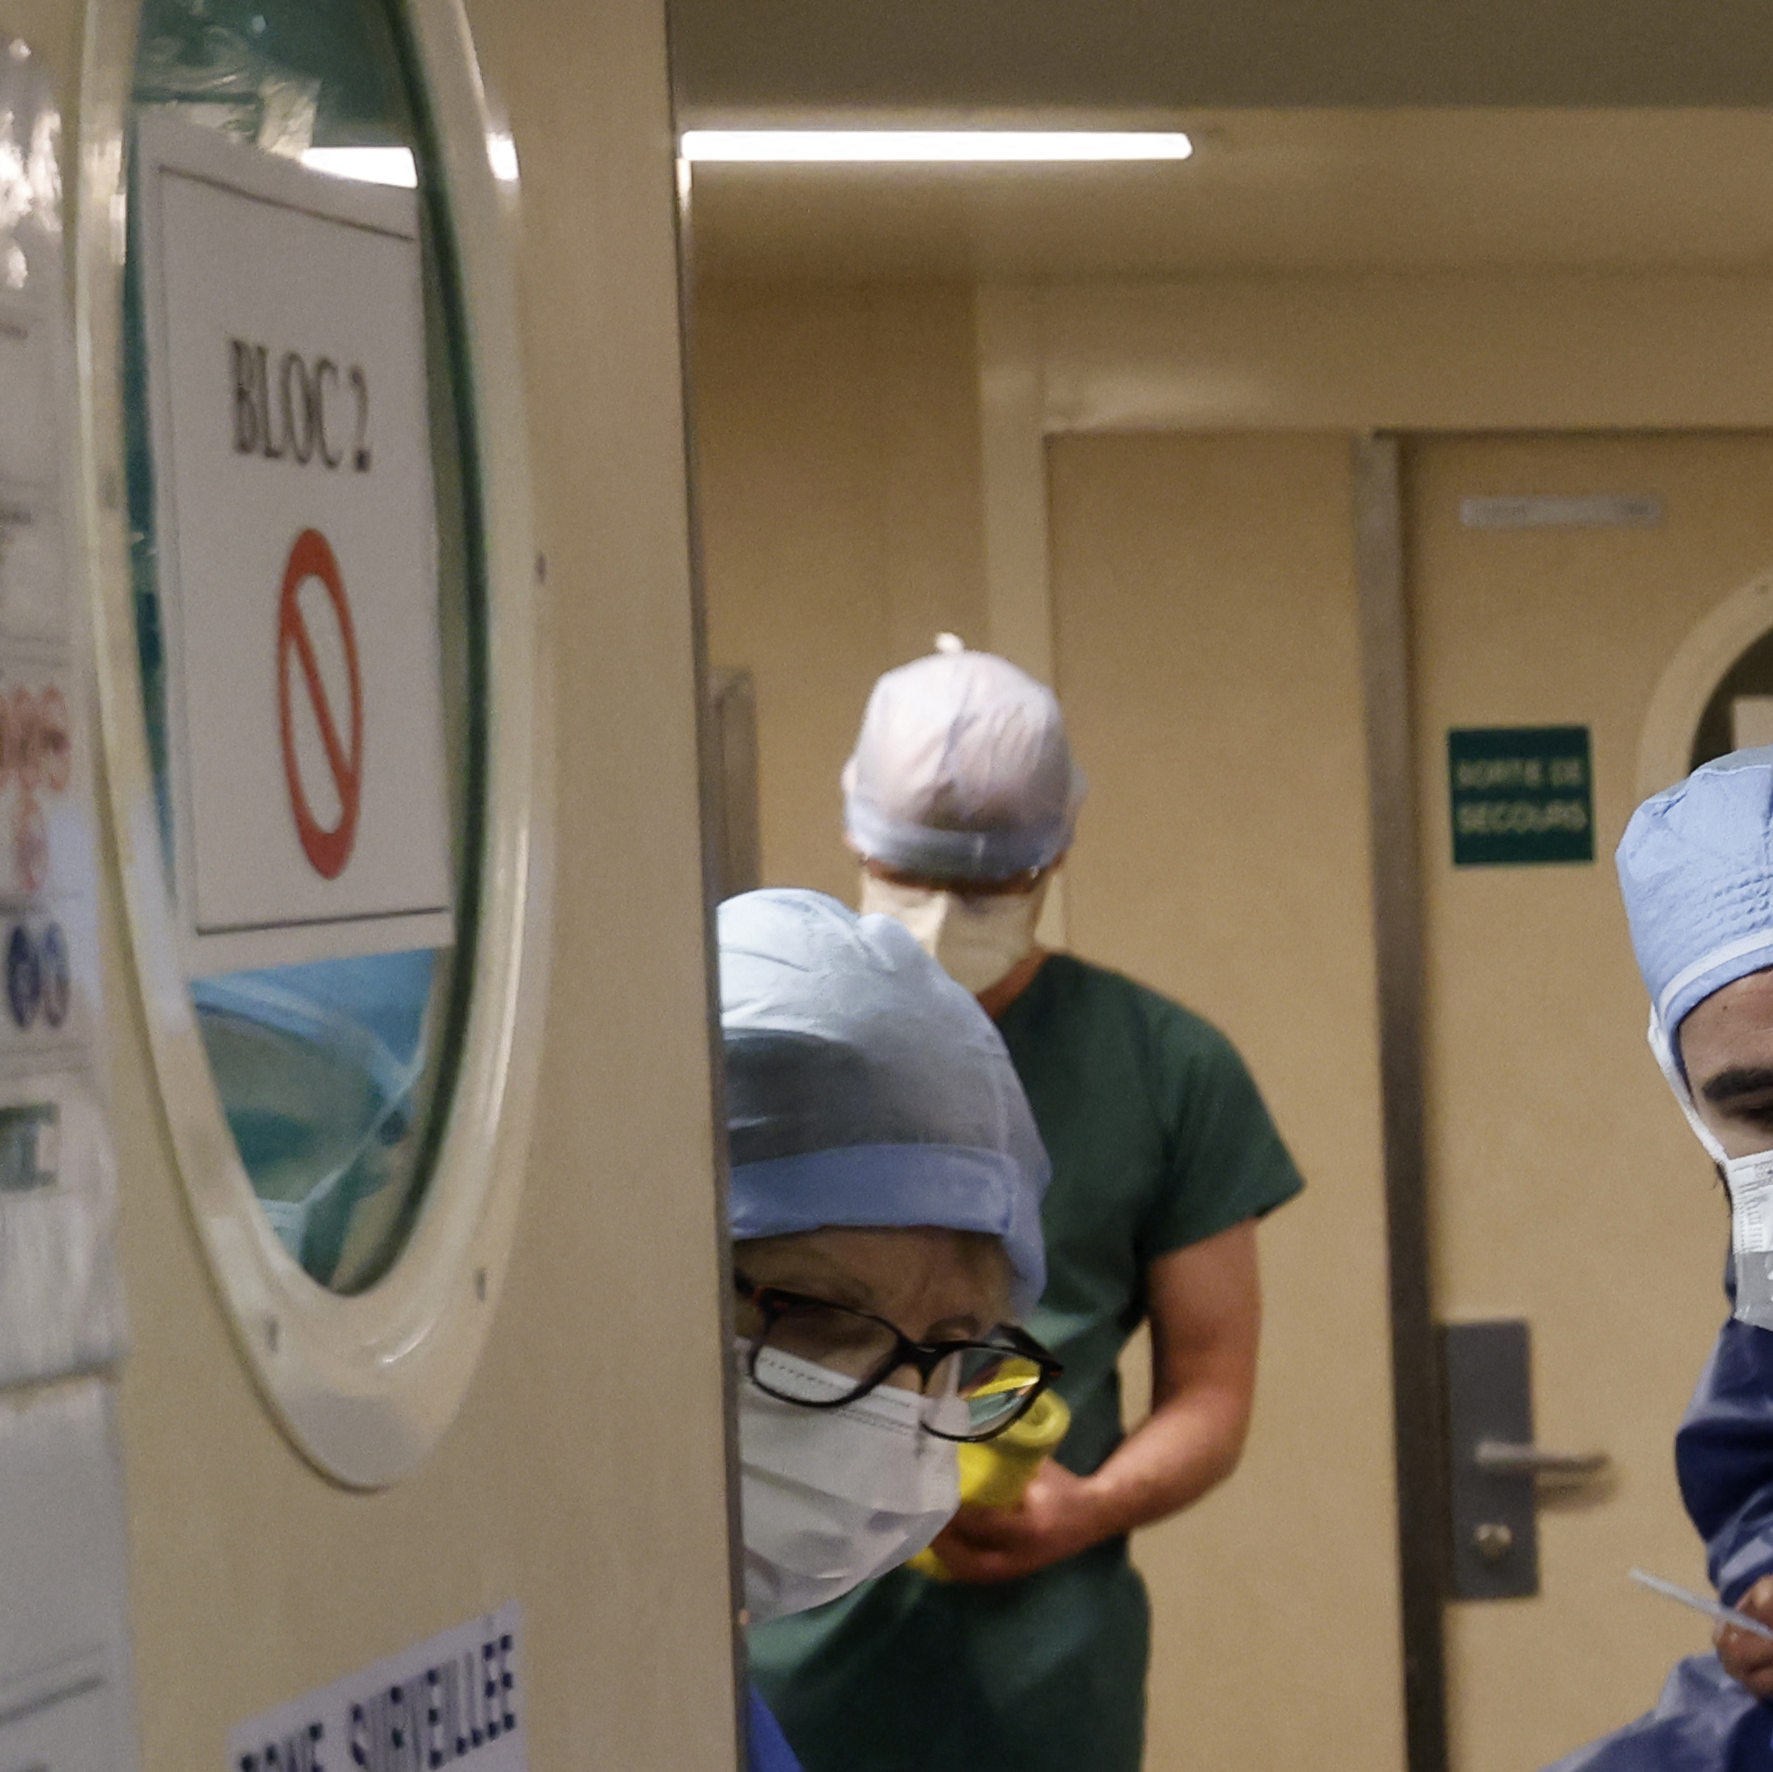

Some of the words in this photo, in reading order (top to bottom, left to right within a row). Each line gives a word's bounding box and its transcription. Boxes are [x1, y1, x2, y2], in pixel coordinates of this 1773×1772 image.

[230, 340, 342, 468] BLOC
[349, 365, 371, 472] 2
[1458, 802, 1588, 833] SECOURS
